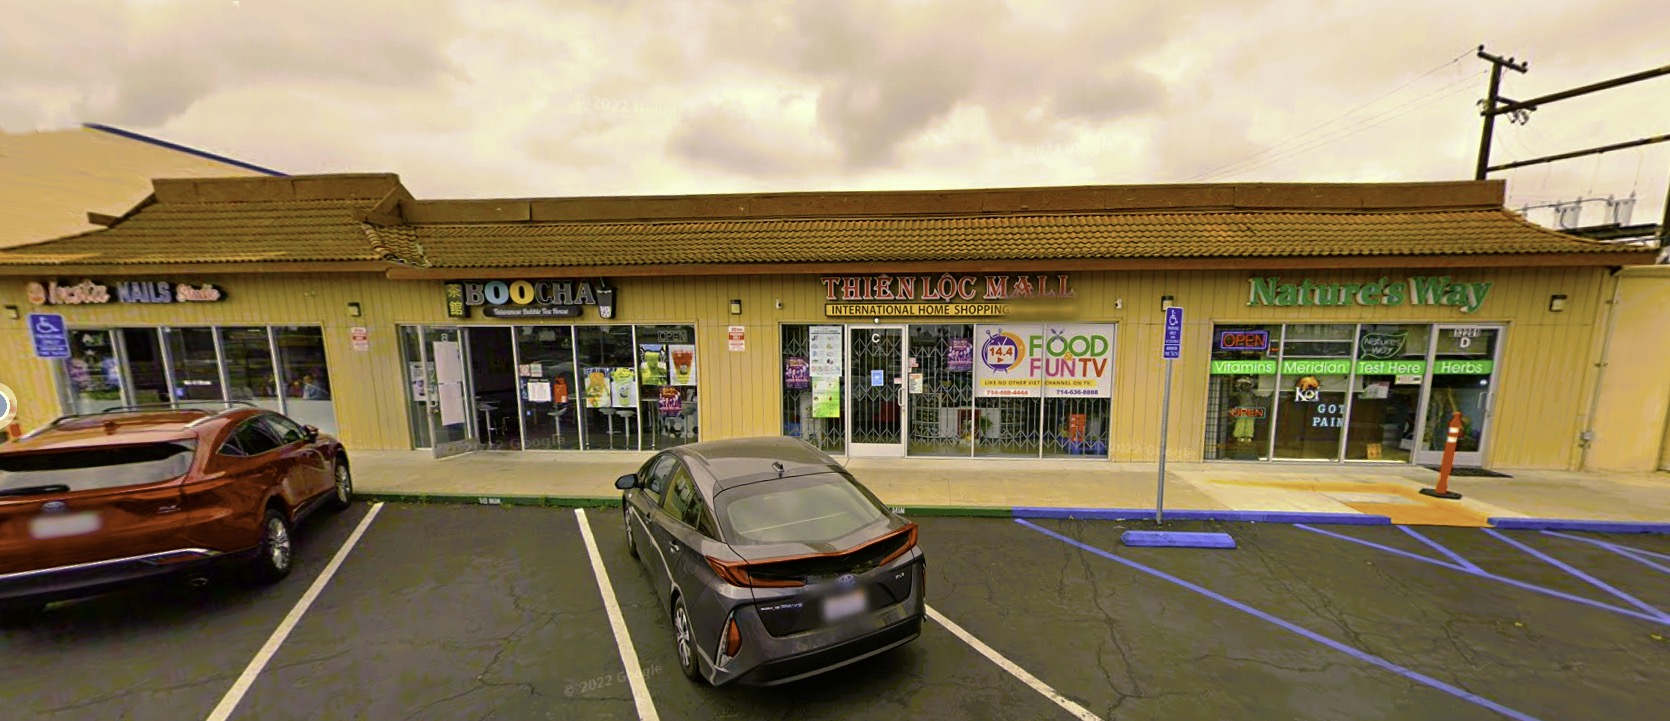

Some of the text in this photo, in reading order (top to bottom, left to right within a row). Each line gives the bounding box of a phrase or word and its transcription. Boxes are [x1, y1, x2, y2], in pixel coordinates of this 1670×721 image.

[117, 282, 173, 303] NAILS
[465, 281, 596, 305] BOOCHA
[821, 273, 1075, 302] THIÊN LỘC MALL
[1246, 276, 1494, 313] Nature's Way
[831, 304, 1010, 315] INTERNATIONAL HOME SHOPPING
[872, 333, 880, 342] C
[1223, 334, 1266, 347] OPEN
[1461, 337, 1471, 348] D
[989, 347, 1013, 356] 14.4
[1029, 335, 1109, 357] FOOD
[1063, 351, 1074, 361] &
[1030, 358, 1108, 378] FUN TV
[1215, 362, 1272, 373] Vitamins
[1285, 361, 1421, 373] Meridian Test Here
[1441, 361, 1483, 373] Herbs
[1317, 404, 1346, 414] GOT
